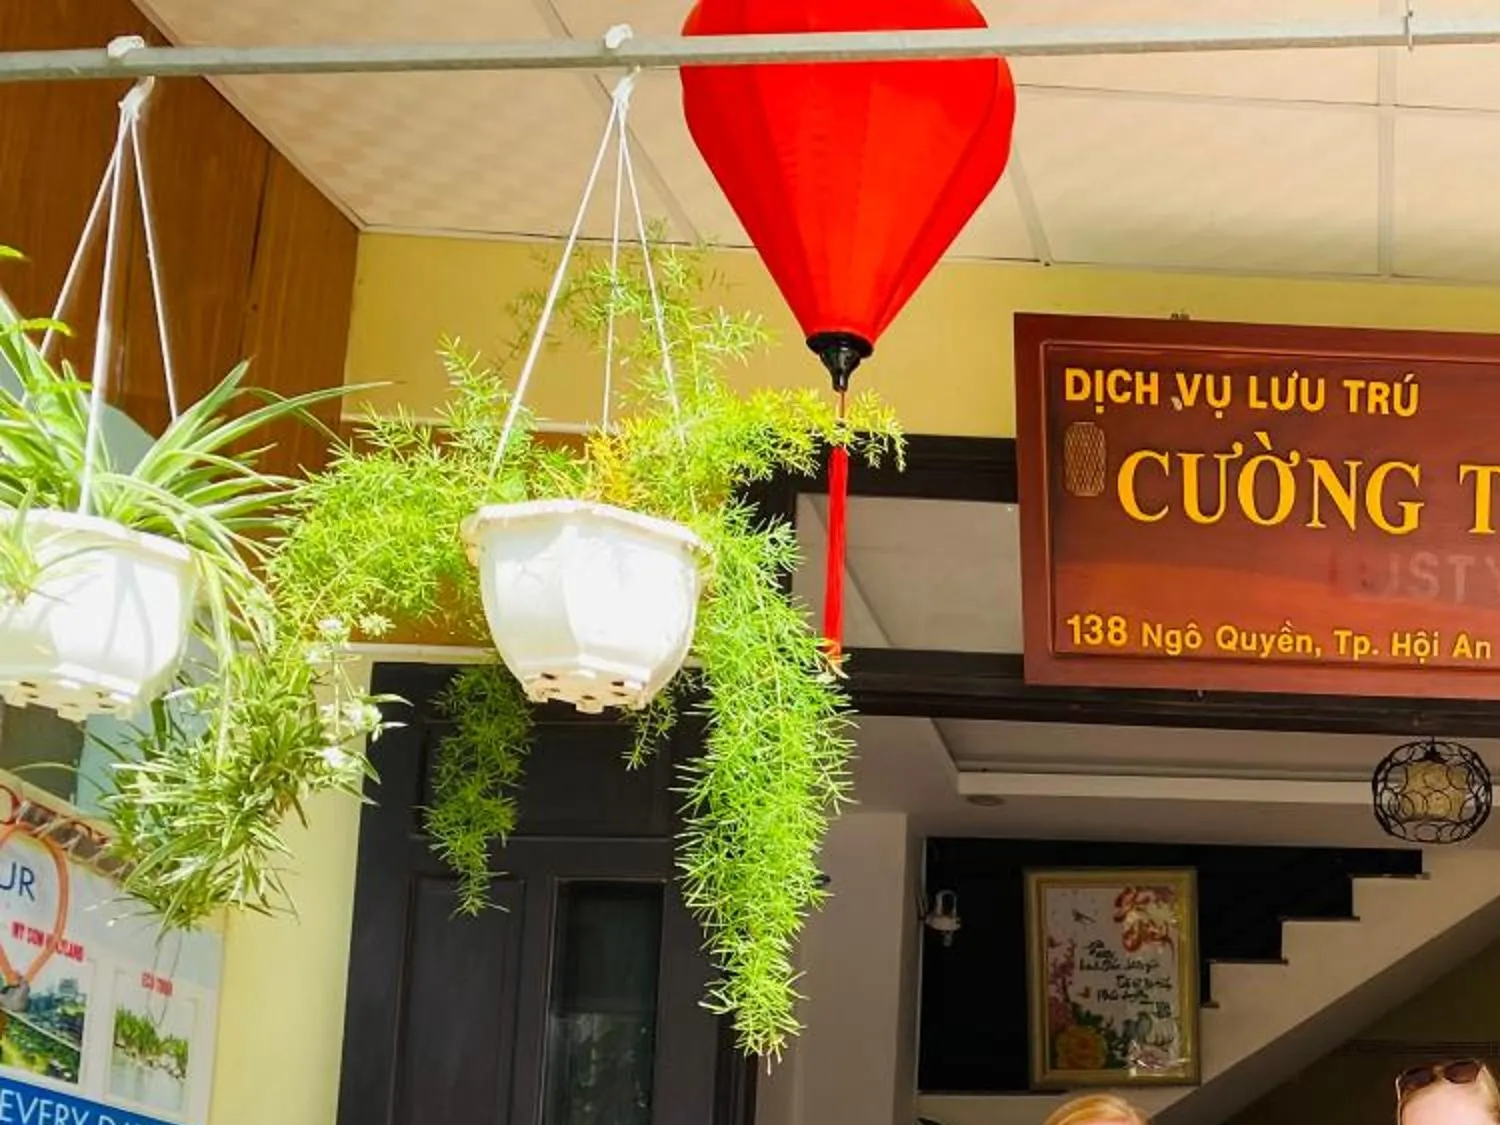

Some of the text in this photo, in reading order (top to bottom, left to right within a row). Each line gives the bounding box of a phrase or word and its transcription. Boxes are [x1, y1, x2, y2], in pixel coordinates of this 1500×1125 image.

[1065, 368, 1419, 419] DỊCH VỤ LƯU TRÚ
[1117, 431, 1425, 535] CƯỜNG
[1066, 614, 1128, 647] 138
[1142, 622, 1203, 656] Ngô
[1215, 619, 1322, 659] Quyền,
[1333, 629, 1380, 661] Tp.
[1391, 630, 1440, 665] Hội
[1451, 633, 1492, 661] An
